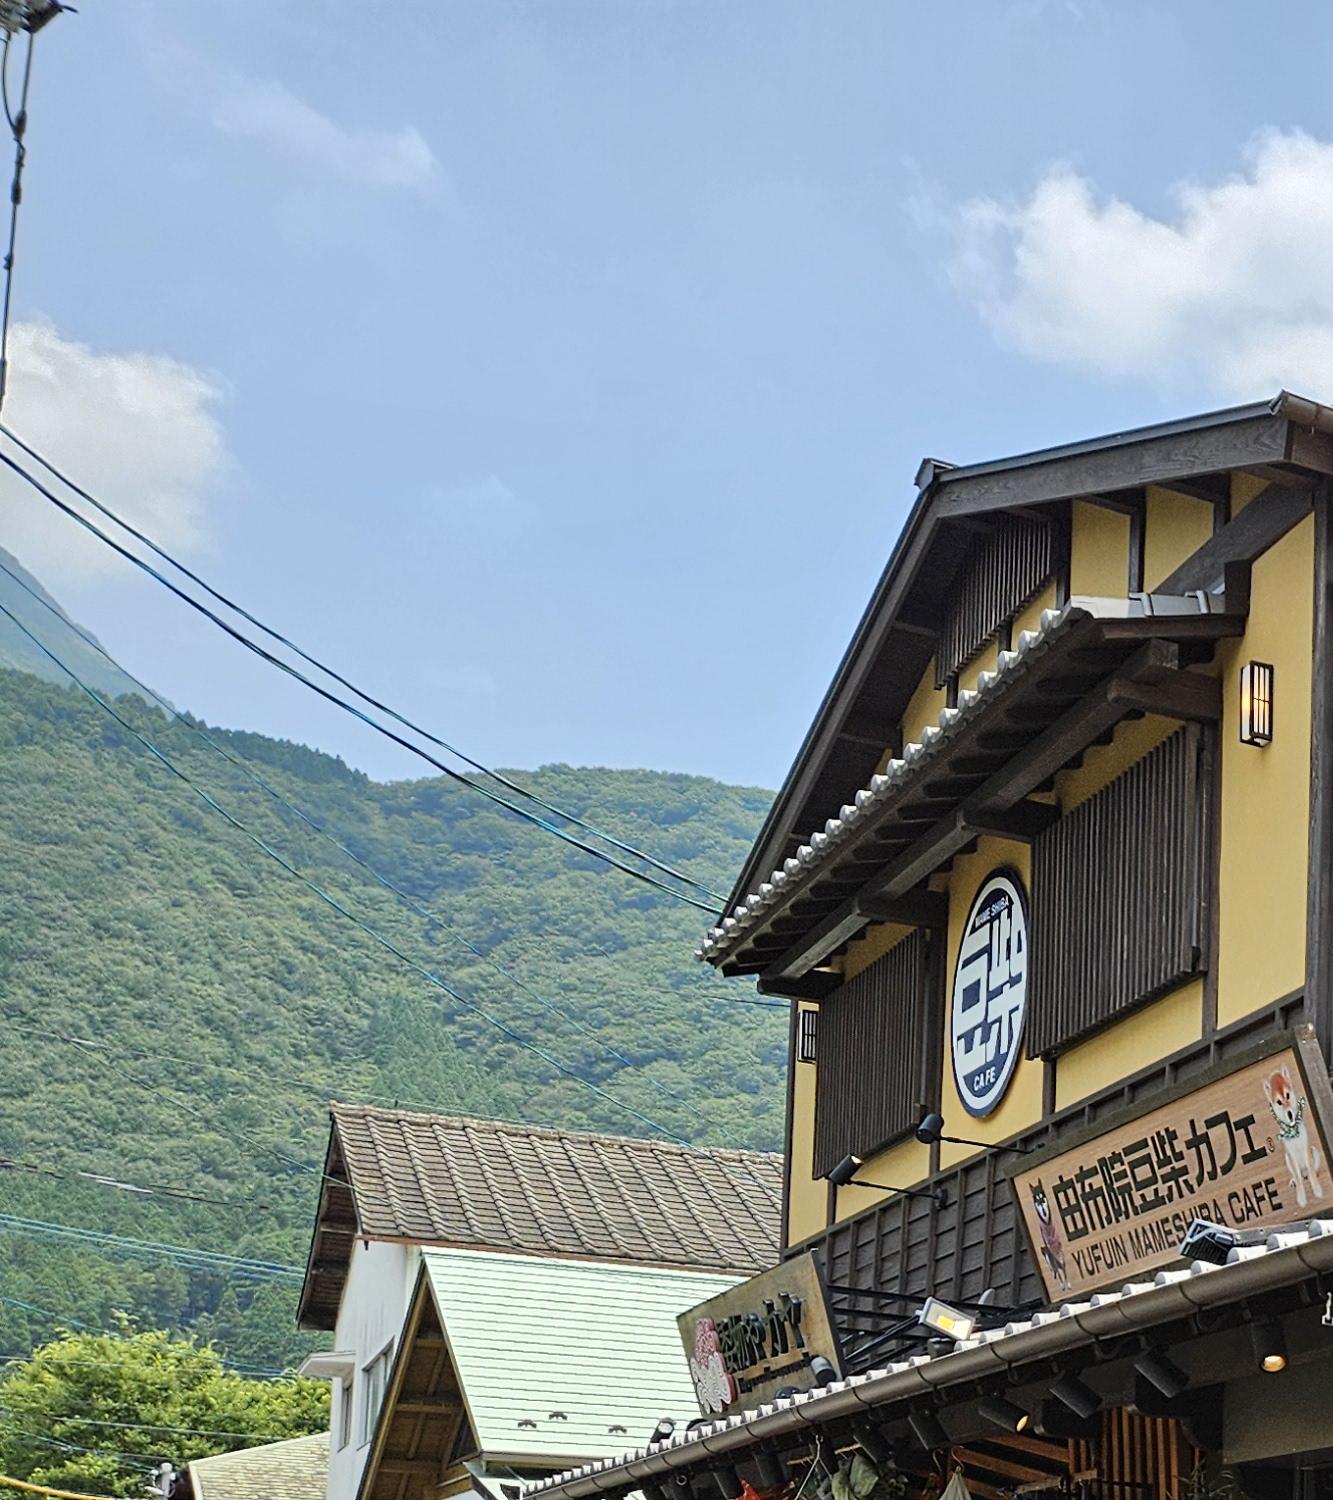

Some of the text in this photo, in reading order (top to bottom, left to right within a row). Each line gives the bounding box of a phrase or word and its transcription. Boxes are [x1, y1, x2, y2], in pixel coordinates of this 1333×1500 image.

[972, 1066, 997, 1092] CAFE
[1051, 1110, 1268, 1242] 由布院豆柴カフェ
[1071, 1233, 1129, 1279] YUFUIN
[1228, 1176, 1284, 1225] CAFE
